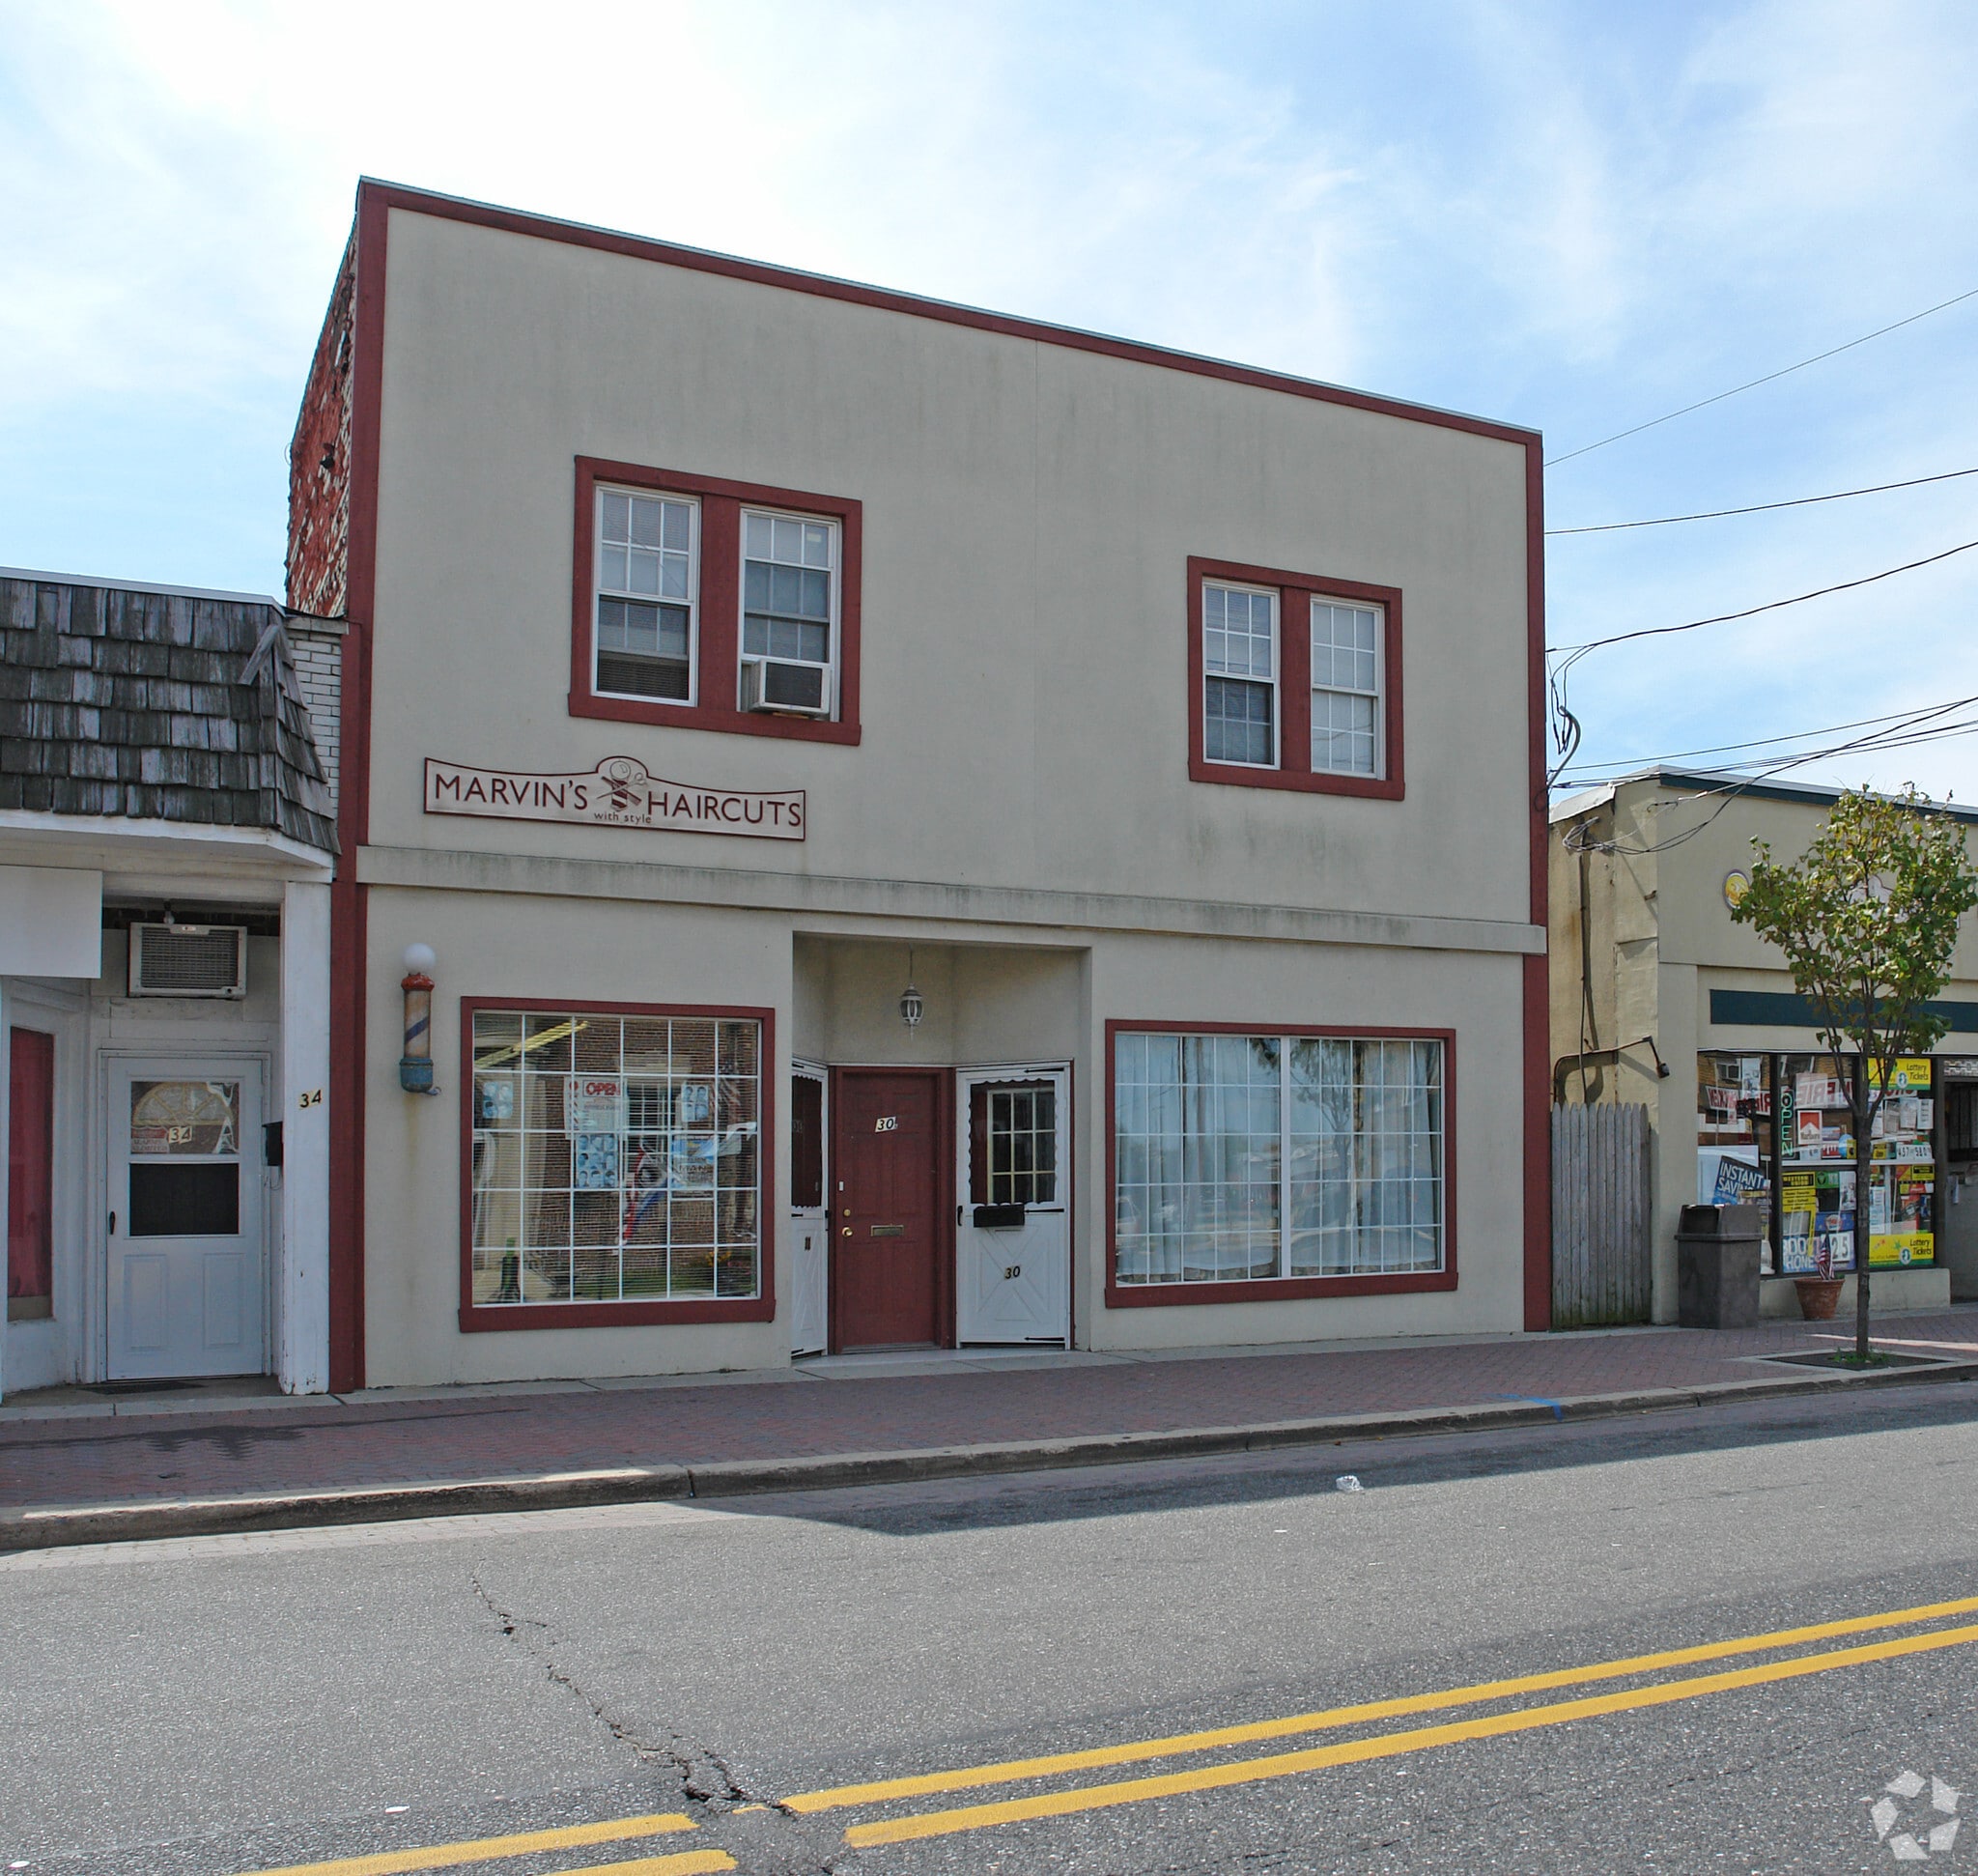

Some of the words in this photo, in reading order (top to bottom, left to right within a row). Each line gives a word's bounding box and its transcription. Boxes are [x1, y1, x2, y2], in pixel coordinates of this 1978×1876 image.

[436, 773, 588, 810] MARVIN'S
[647, 790, 801, 827] HAIRCUTS
[594, 810, 621, 822] with
[625, 814, 652, 825] style
[1907, 1064, 1927, 1072] Lottery
[1909, 1072, 1929, 1081] Tickets
[300, 1090, 323, 1108] 34
[877, 1119, 894, 1130] 30
[1780, 1093, 1794, 1157] OPEN
[170, 1127, 191, 1141] 34
[1719, 1162, 1765, 1188] INSTANT
[1910, 1238, 1930, 1247] Lottery
[1913, 1247, 1932, 1256] Tickets
[1004, 1265, 1021, 1279] 30
